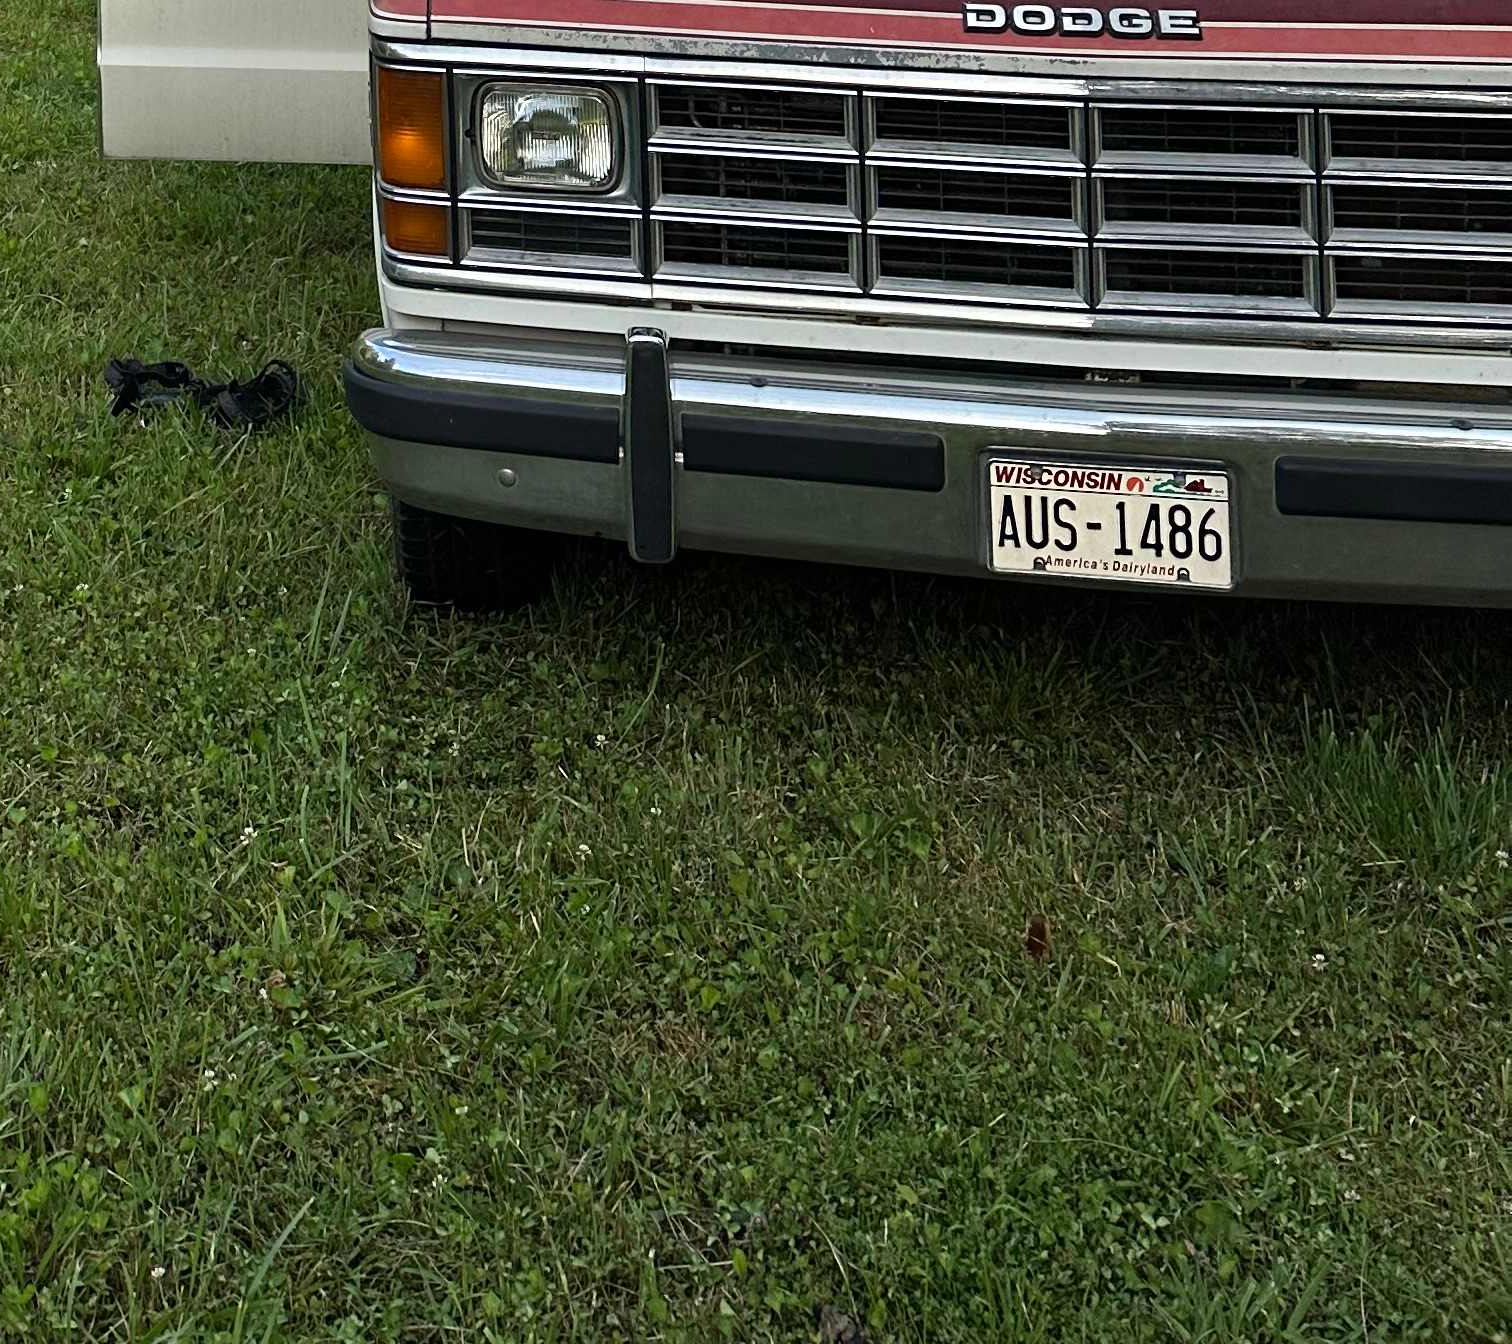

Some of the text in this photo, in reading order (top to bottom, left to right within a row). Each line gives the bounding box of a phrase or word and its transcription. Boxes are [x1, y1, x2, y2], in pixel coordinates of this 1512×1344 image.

[963, 2, 1203, 41] DODGE
[995, 465, 1123, 491] WISCONSIN
[998, 494, 1223, 562] AUS-1486
[1045, 555, 1175, 577] America's Dairyland
